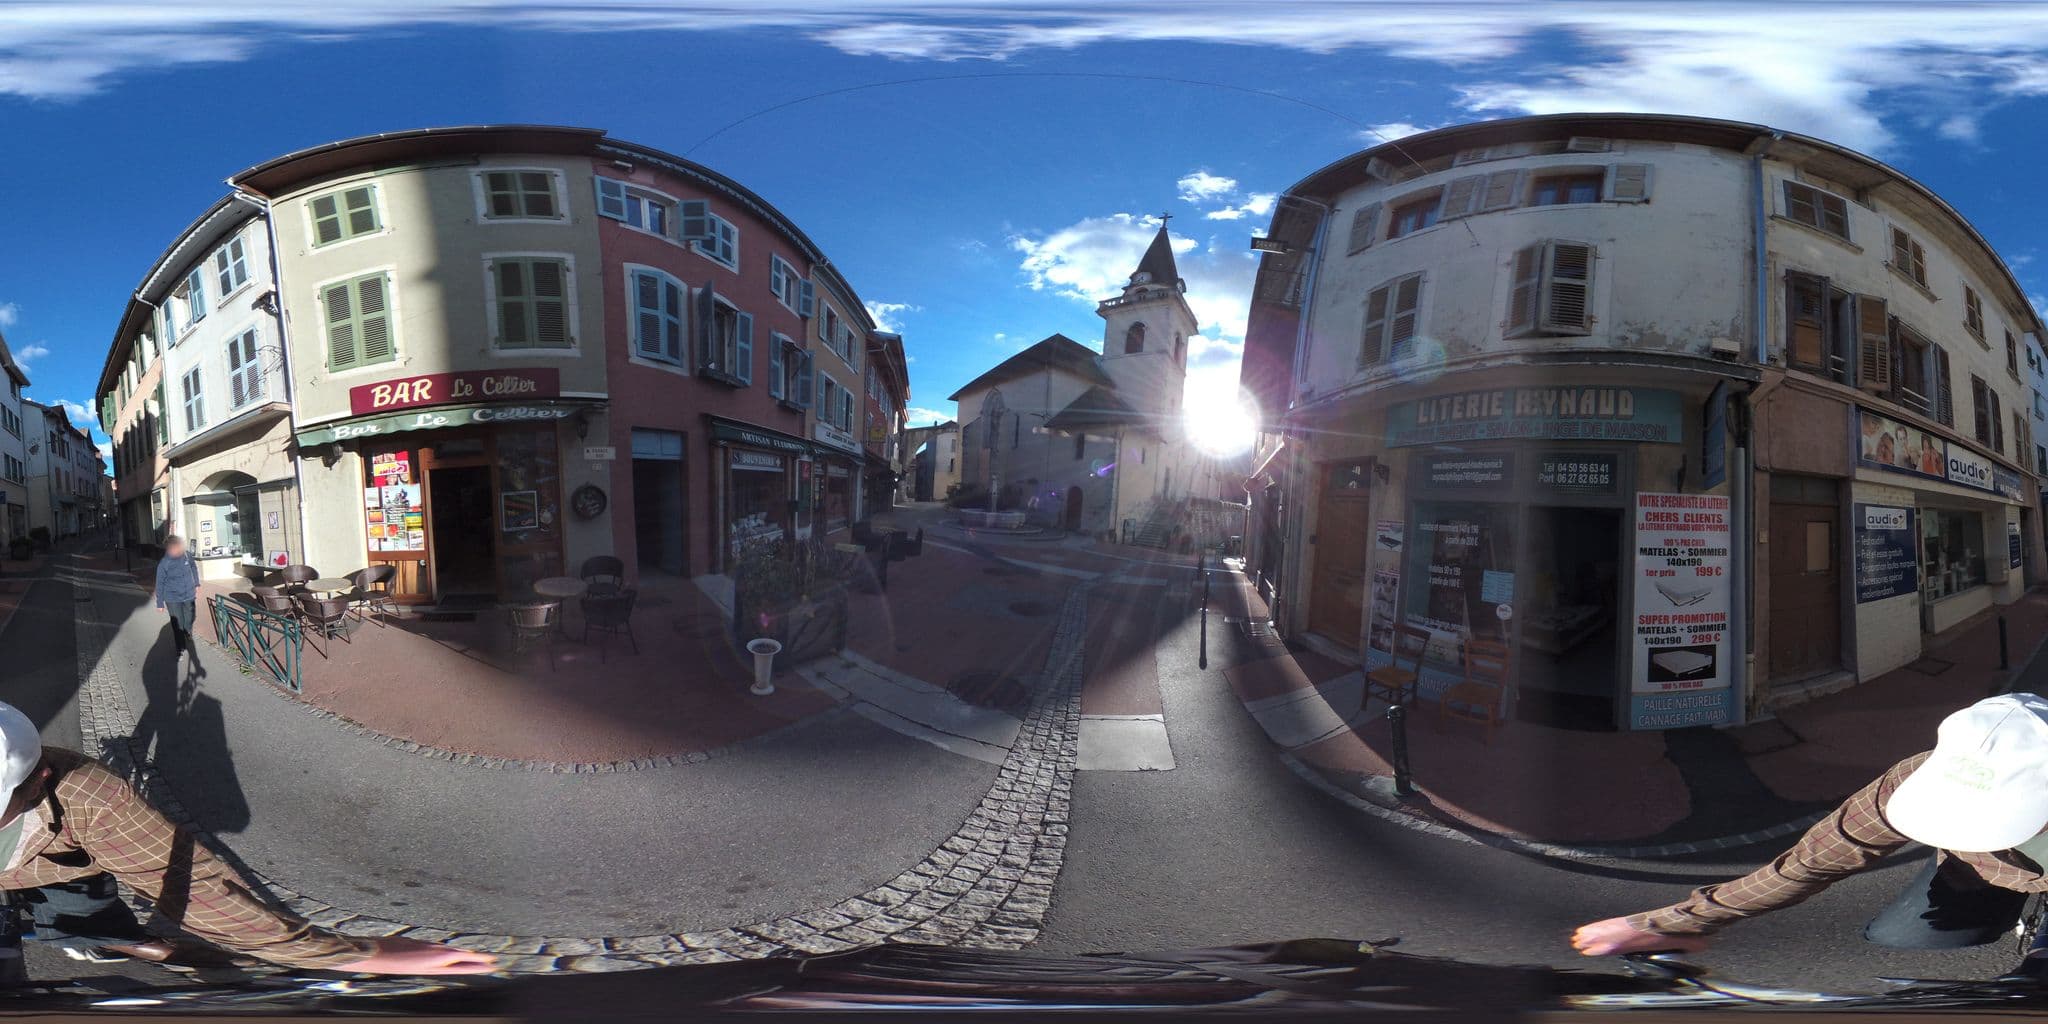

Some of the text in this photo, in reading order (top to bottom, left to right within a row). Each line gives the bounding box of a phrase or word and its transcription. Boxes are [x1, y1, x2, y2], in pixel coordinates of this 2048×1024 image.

[371, 376, 537, 408] BAR Le Cellier
[1417, 391, 1504, 424] LITERIE
[334, 406, 569, 440] Bar Le Cellier
[1606, 421, 1667, 440] MAISON
[1557, 462, 1567, 472] 04
[1568, 462, 1577, 472] 50
[1599, 463, 1609, 472] 41
[1557, 473, 1567, 484] 06
[1568, 473, 1577, 484] 27
[1639, 495, 1660, 508] VOTRE
[1699, 496, 1707, 508] EN
[1708, 497, 1728, 510] LITERIE
[1645, 512, 1723, 524] CHERS CLIENTS
[1638, 523, 1645, 531] LA
[1640, 547, 1679, 556] MATELAS
[1687, 548, 1728, 556] SOMMIER
[1666, 558, 1702, 567] 140x190
[1695, 566, 1713, 576] 199
[1715, 567, 1722, 576] €
[1639, 612, 1726, 624] SUPER PROMOTION
[1638, 625, 1677, 634] MATELAS
[1686, 623, 1727, 633] SOMMIER
[1644, 633, 1721, 645] 140x190 299 €
[1643, 694, 1722, 711] PAILLE NATURELLE
[1638, 709, 1728, 727] CANNAGE FAIT MAIN
